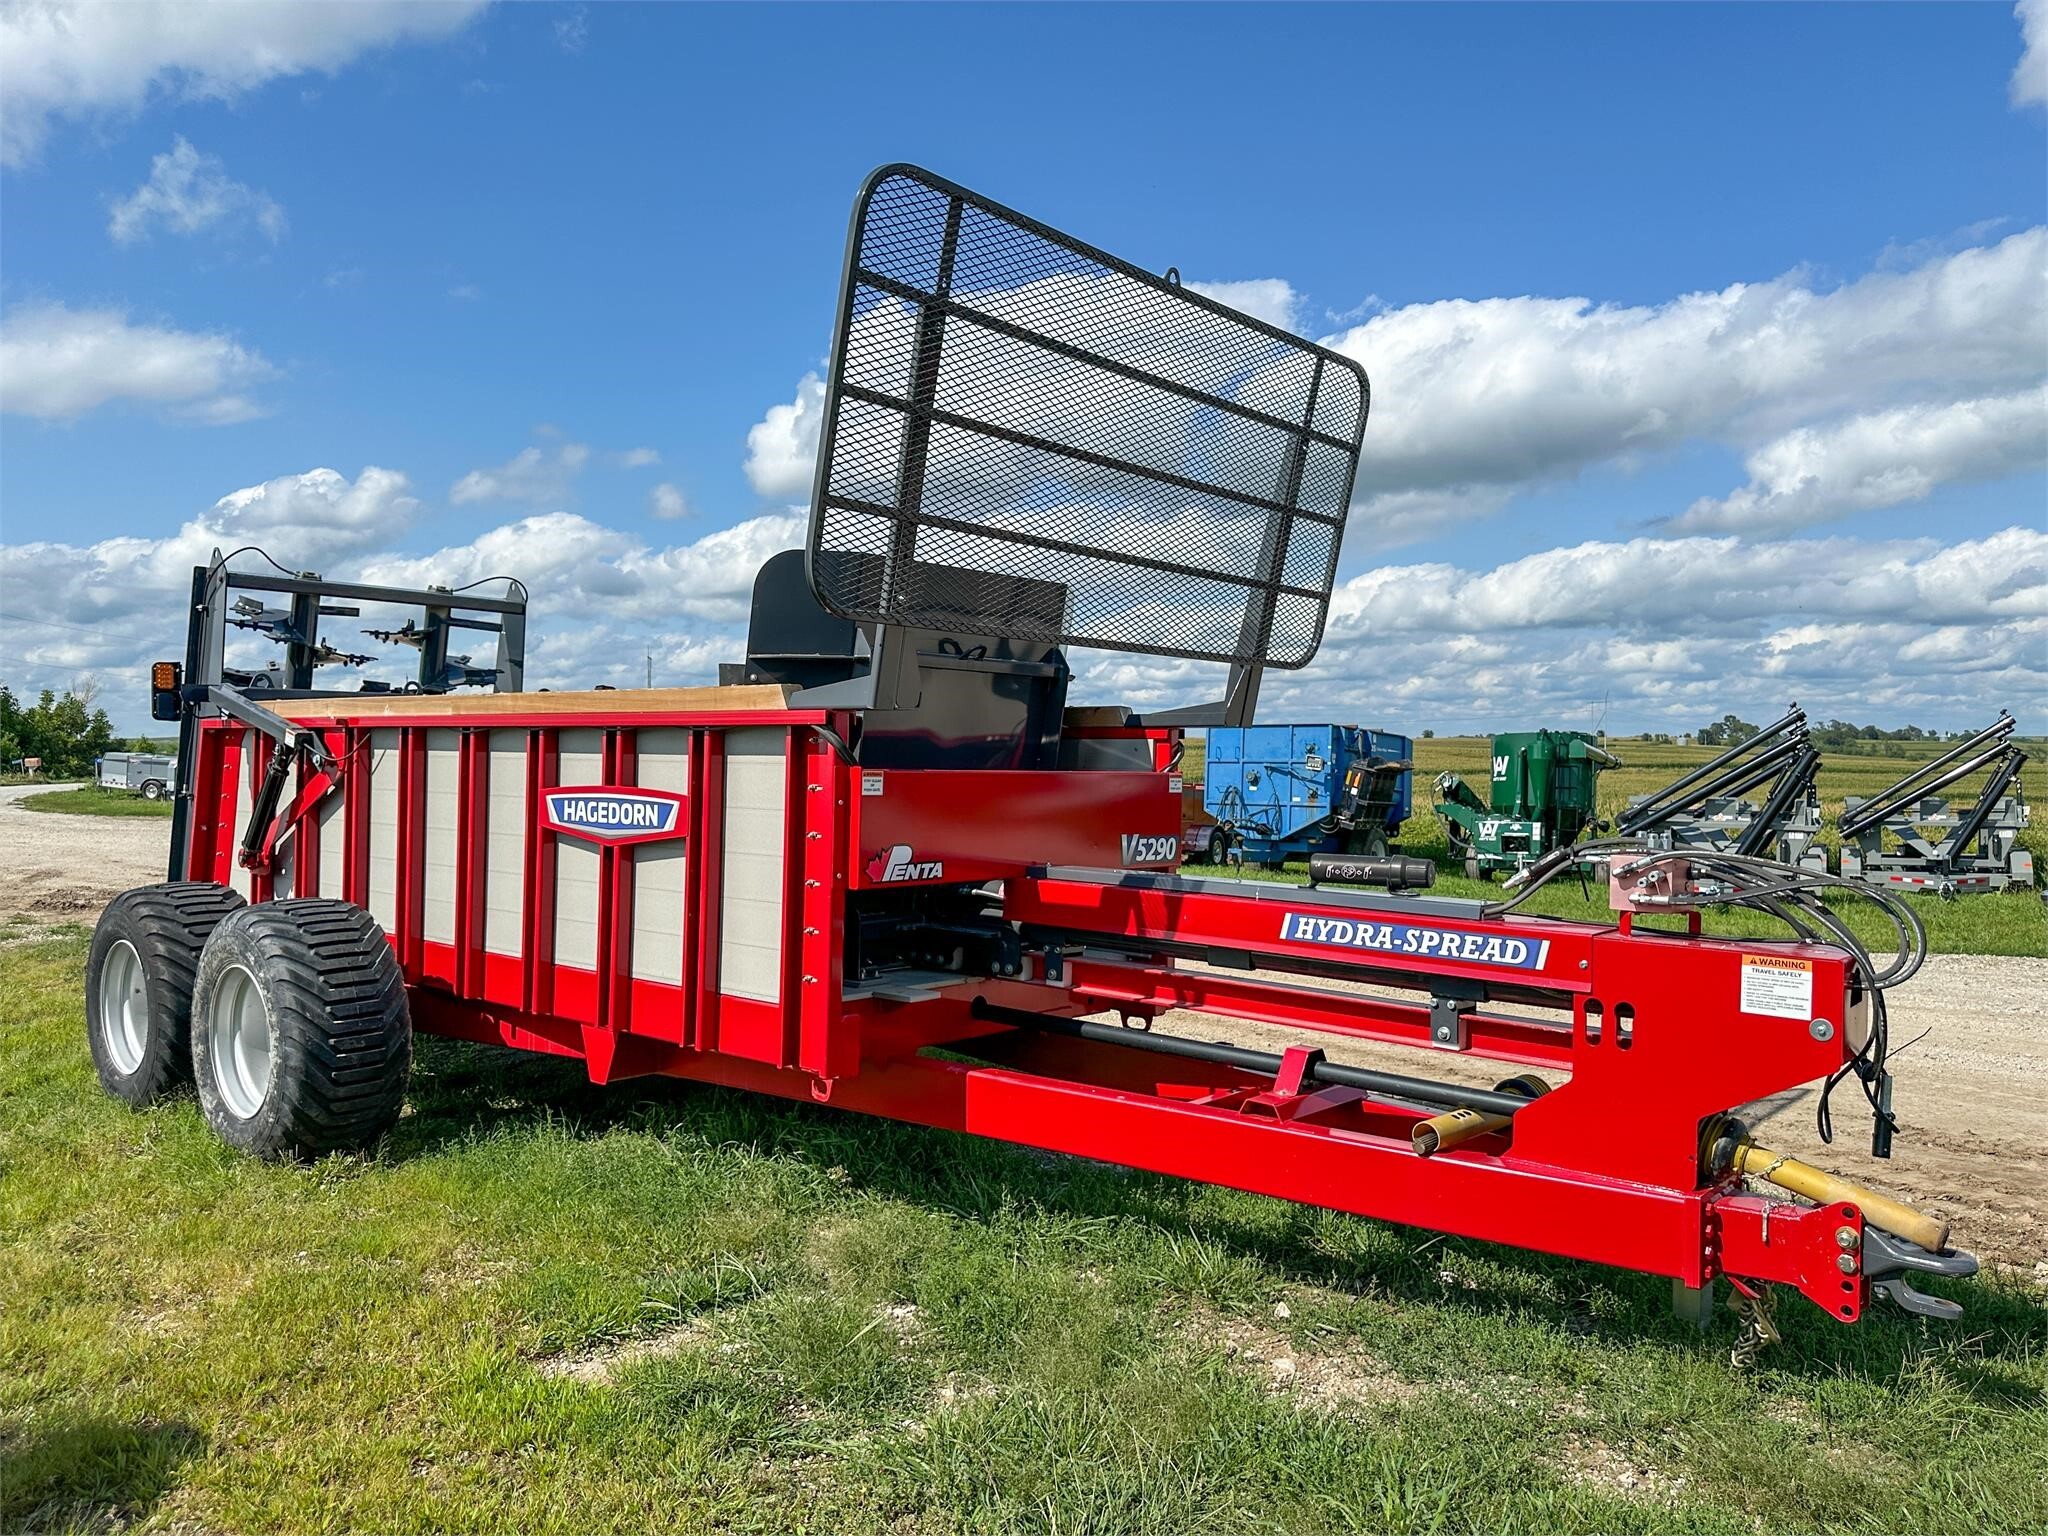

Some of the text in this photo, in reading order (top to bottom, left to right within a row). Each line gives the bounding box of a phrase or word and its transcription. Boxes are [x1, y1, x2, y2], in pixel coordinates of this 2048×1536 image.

[563, 799, 659, 826] HAGEDORN
[881, 844, 943, 883] PENTA
[1120, 833, 1177, 866] V5290
[1294, 916, 1529, 966] HYDRA-SPREAD
[1752, 967, 1802, 978] TRAVEL SAFELY
[1758, 958, 1806, 970] WARNING
